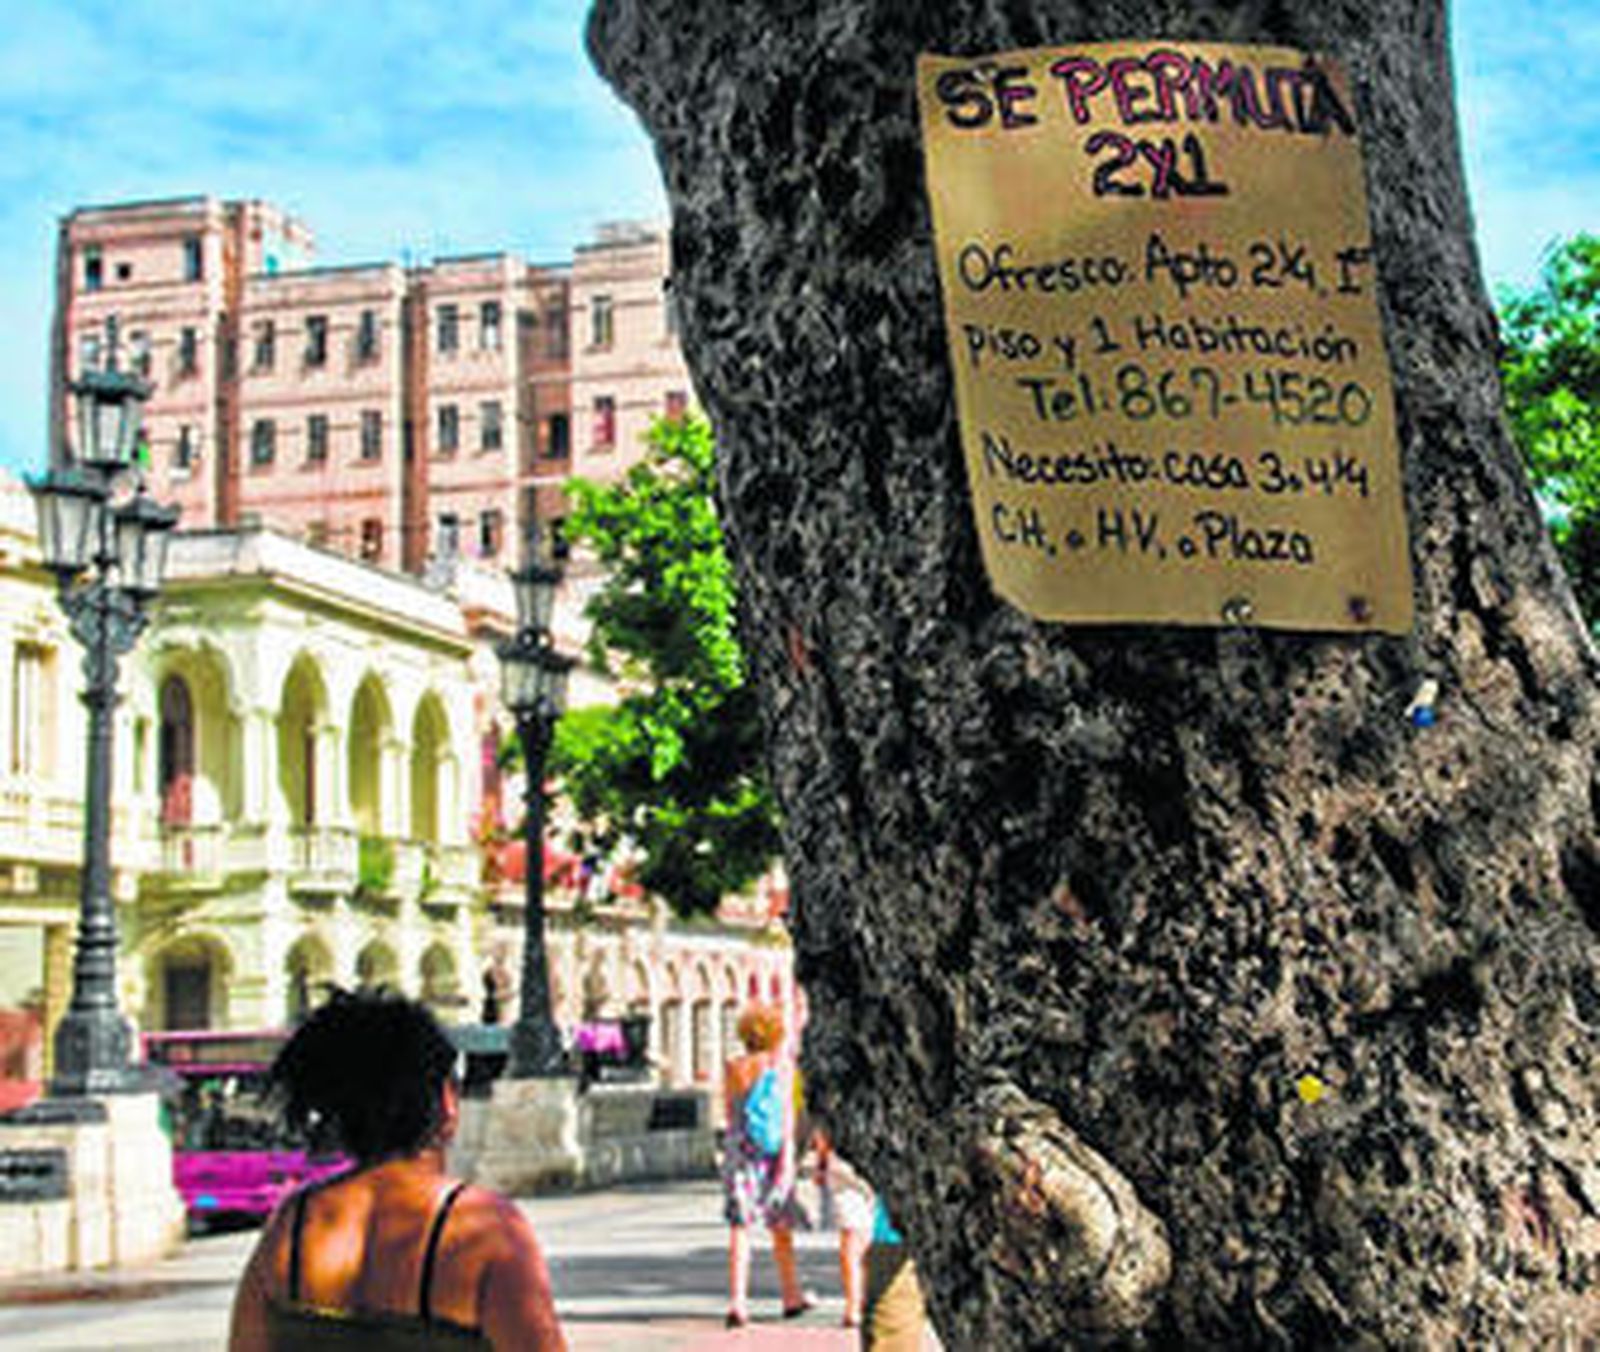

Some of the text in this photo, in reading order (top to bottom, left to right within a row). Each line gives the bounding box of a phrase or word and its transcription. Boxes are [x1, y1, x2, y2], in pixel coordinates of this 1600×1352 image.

[936, 49, 1357, 136] SE PERMUTA
[1146, 234, 1238, 298] Apto
[963, 323, 1042, 368] piso
[1054, 333, 1076, 370] y
[1091, 315, 1122, 353] 1
[1115, 362, 1372, 427] 867-4520
[1163, 451, 1249, 490] casa
[1194, 510, 1313, 565] Plaza
